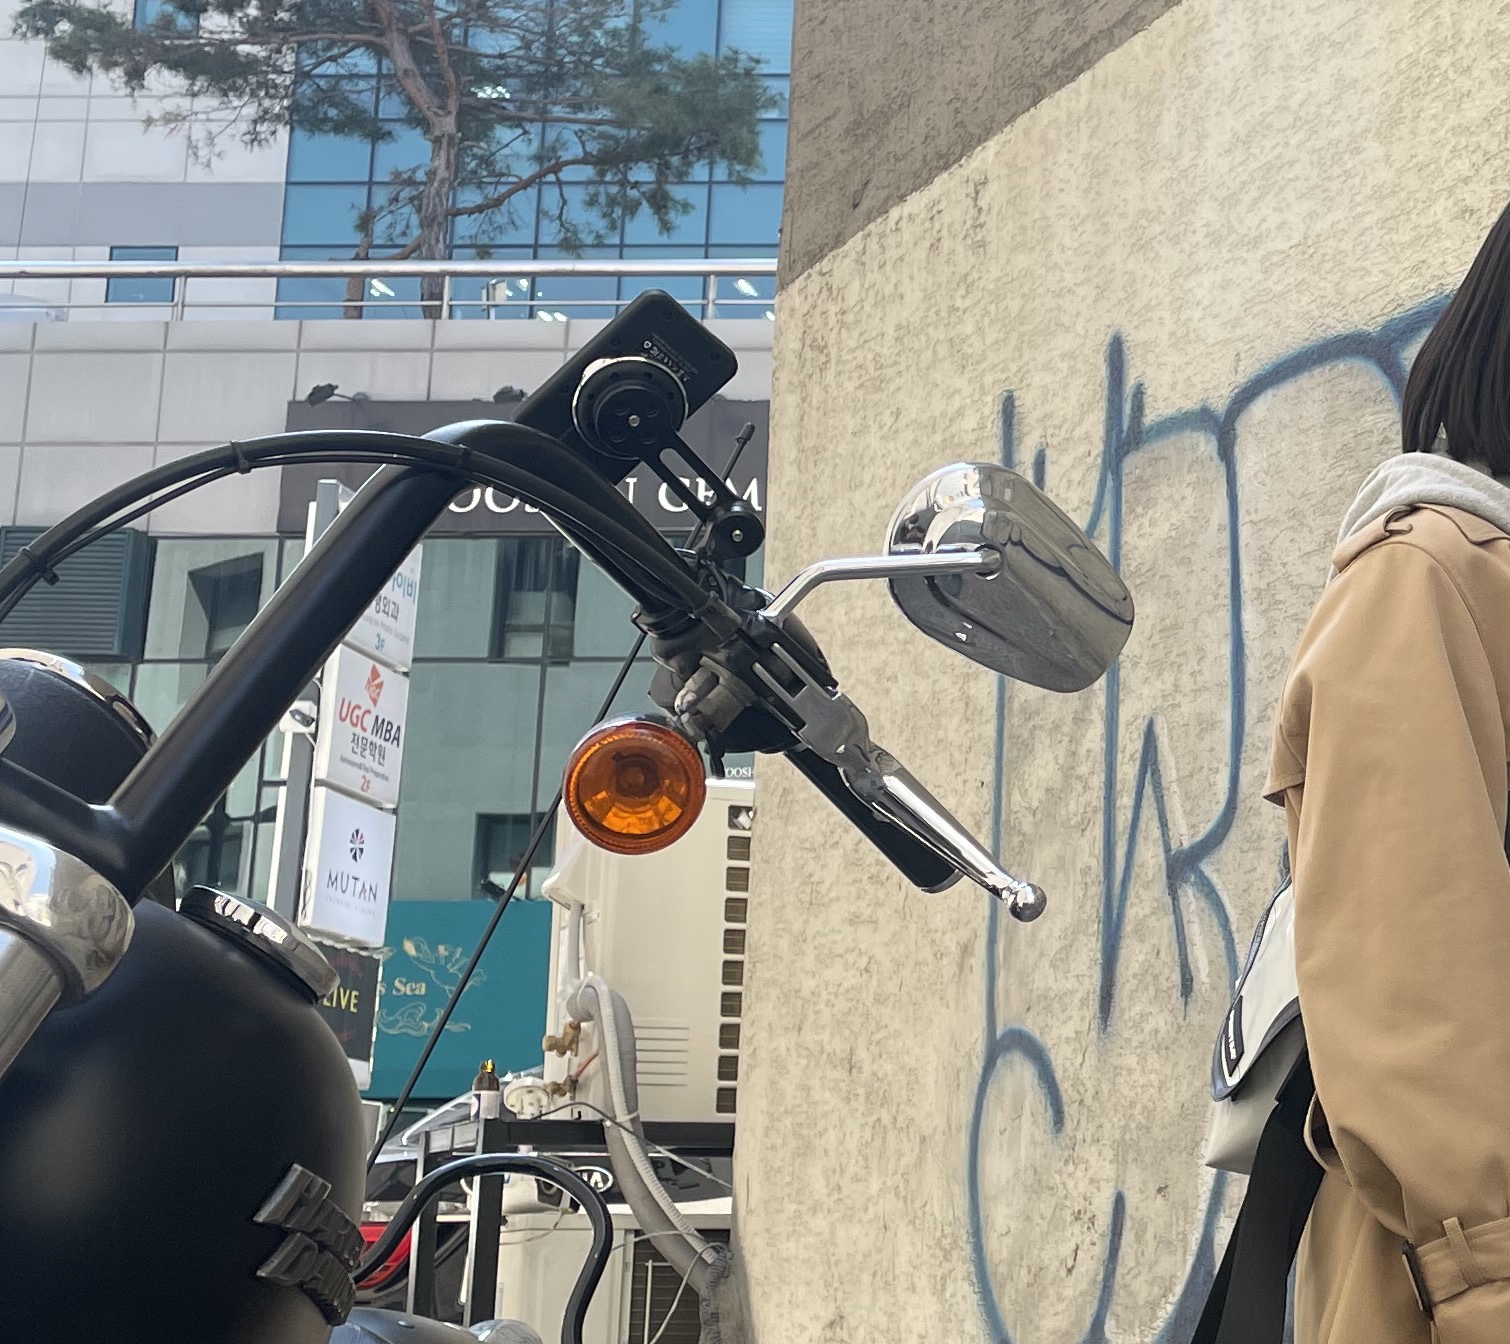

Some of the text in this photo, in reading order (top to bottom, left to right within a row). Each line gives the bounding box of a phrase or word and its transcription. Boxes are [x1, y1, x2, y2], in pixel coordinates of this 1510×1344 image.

[391, 571, 417, 605] 이비
[338, 697, 402, 749] UGC MBA
[350, 732, 386, 768] 전문학원
[326, 868, 379, 904] MUTAN
[392, 976, 427, 996] Sea
